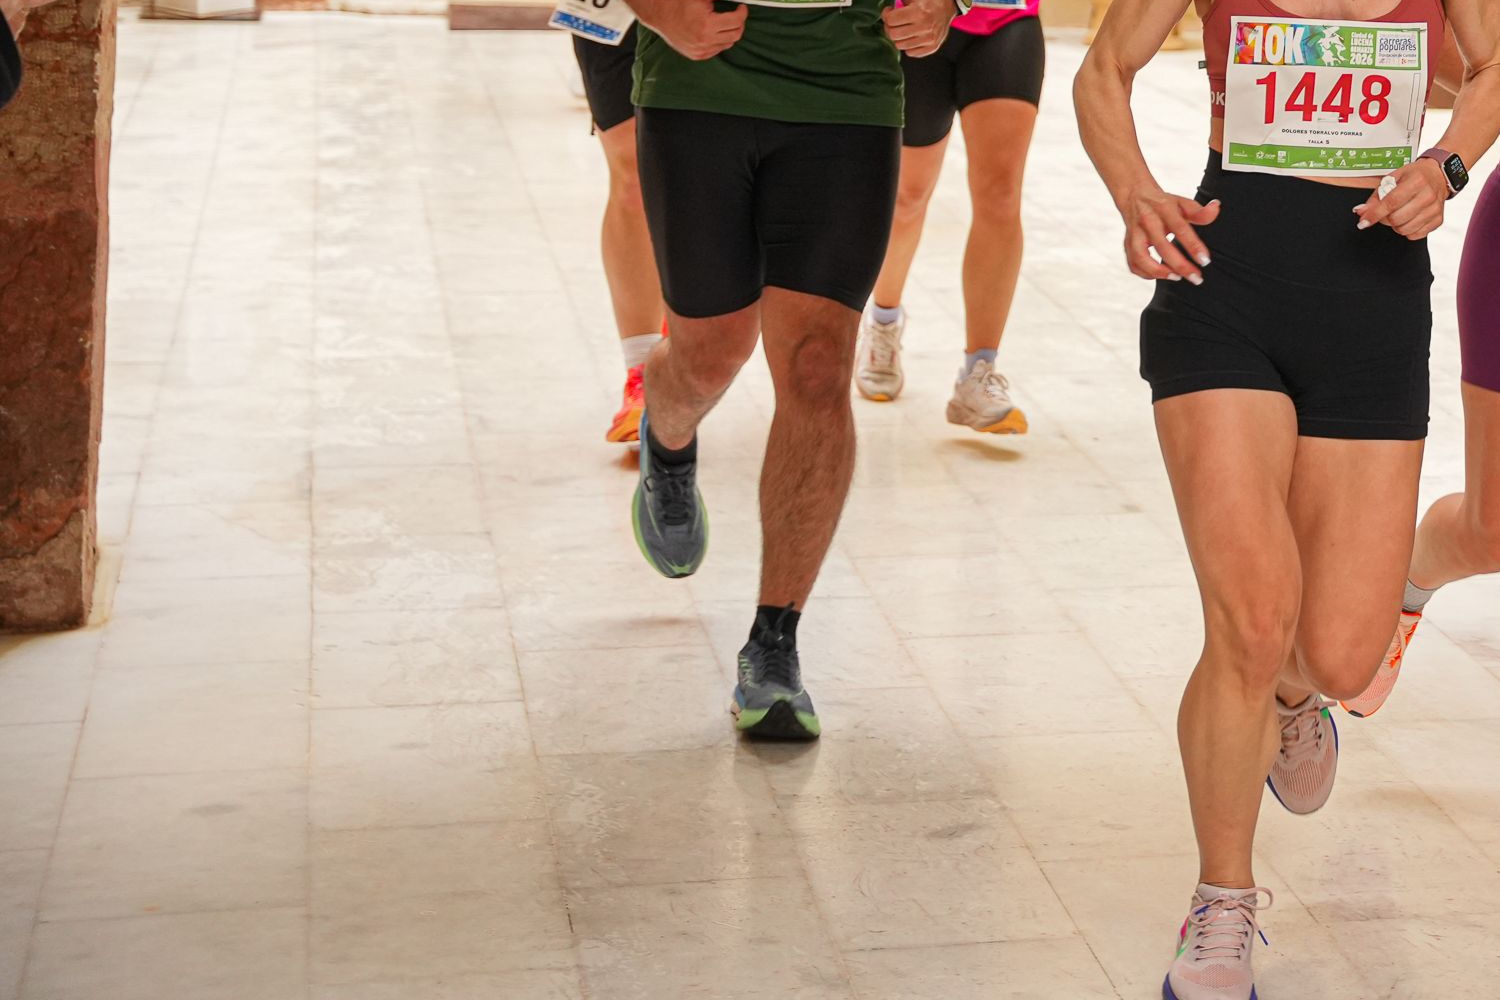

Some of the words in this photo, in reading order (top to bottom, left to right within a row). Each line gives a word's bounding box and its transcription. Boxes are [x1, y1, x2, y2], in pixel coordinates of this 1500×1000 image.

[1247, 25, 1306, 65] 10K
[1379, 37, 1412, 47] carreras
[1379, 43, 1416, 53] populares
[1350, 53, 1373, 65] 2026
[1256, 71, 1392, 125] 1448
